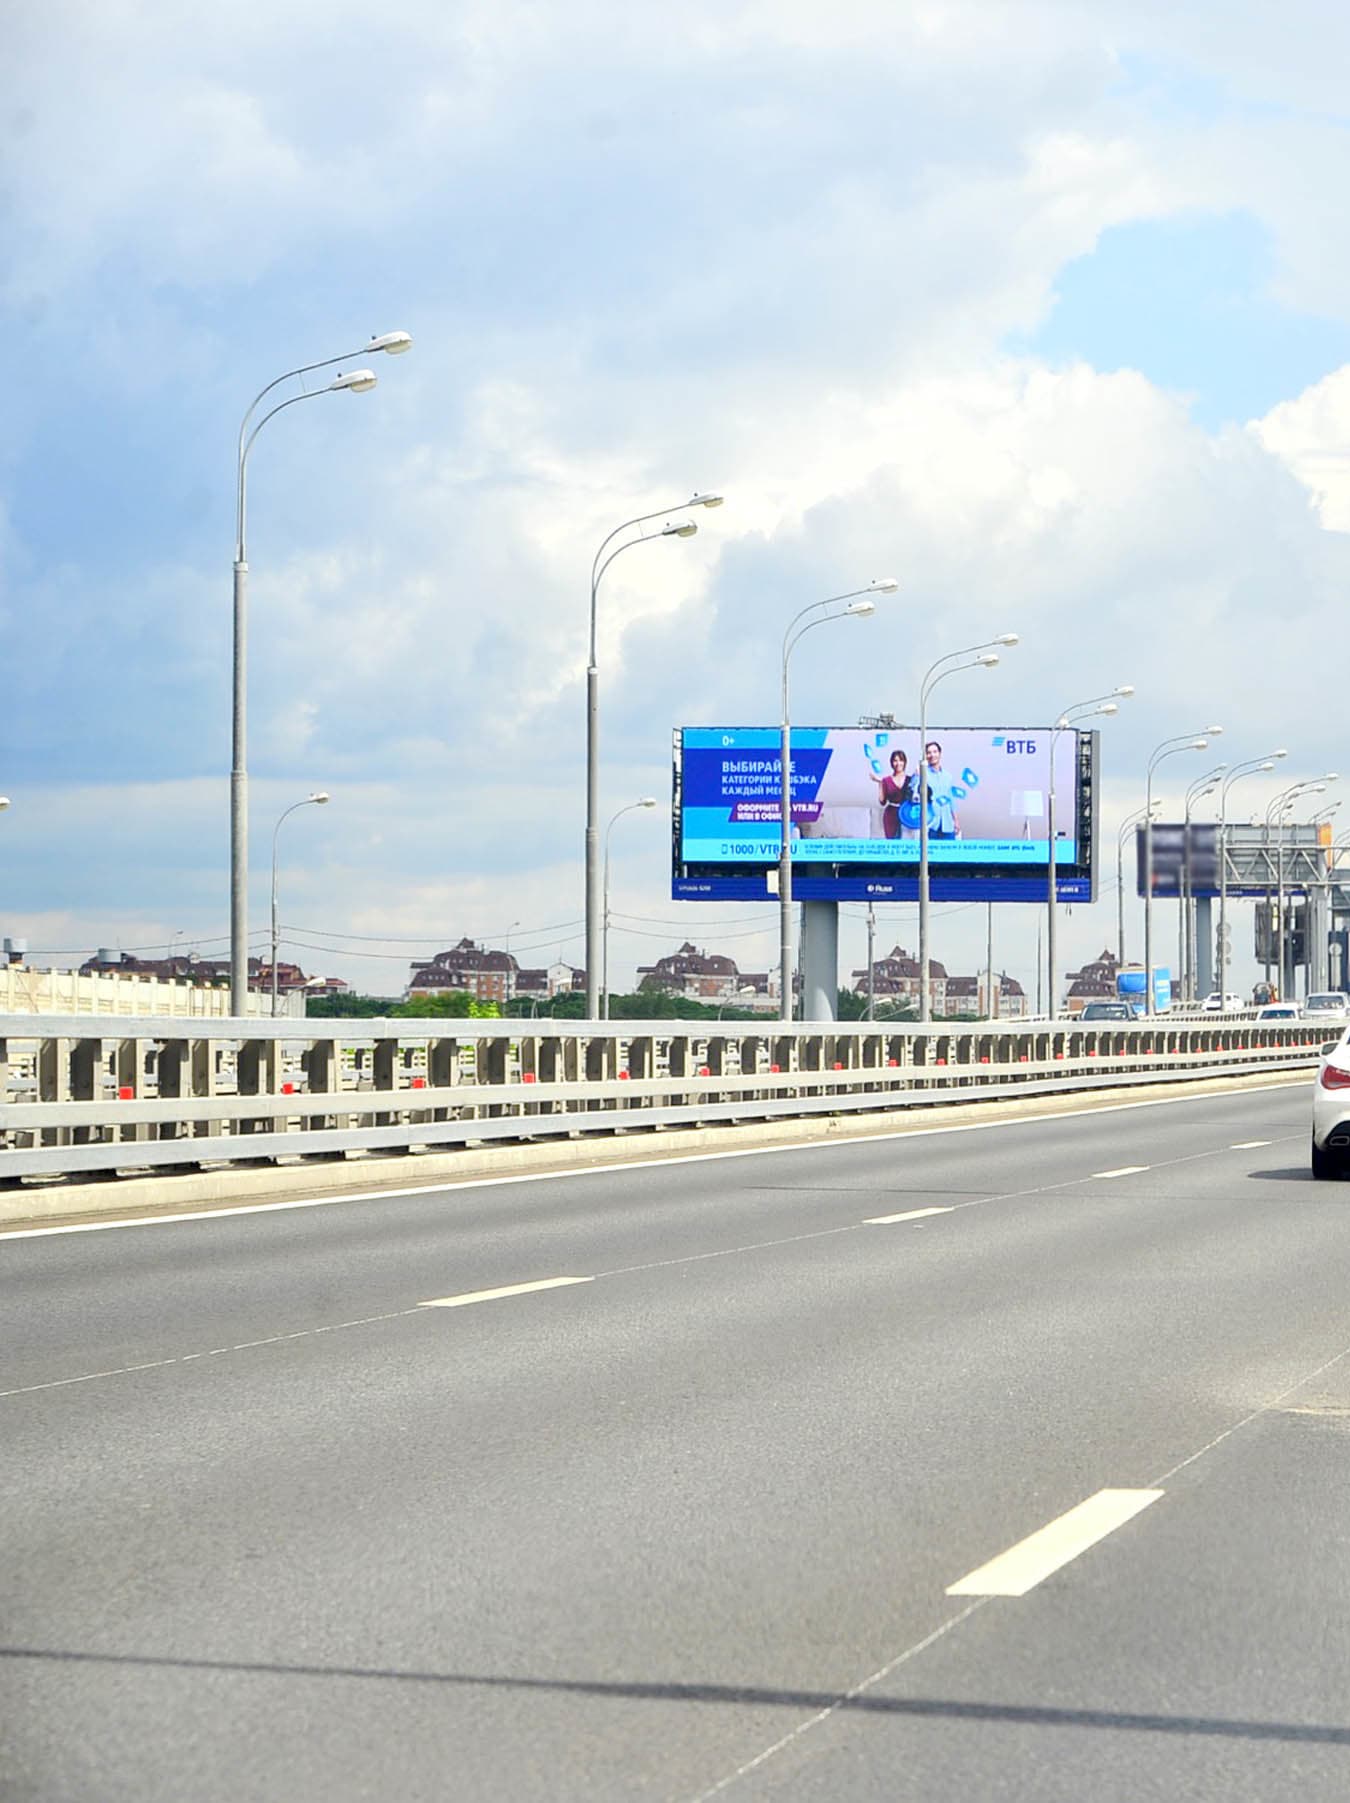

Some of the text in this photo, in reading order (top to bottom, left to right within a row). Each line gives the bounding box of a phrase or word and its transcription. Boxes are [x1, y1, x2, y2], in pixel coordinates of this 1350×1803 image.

[722, 735, 735, 746] 0+
[1006, 740, 1036, 754] ВТБ
[722, 759, 796, 773] ВЫБИРАЙЕ
[722, 775, 772, 784] КАТЕГОРИИ
[722, 785, 764, 797] КАЖДЫЙ
